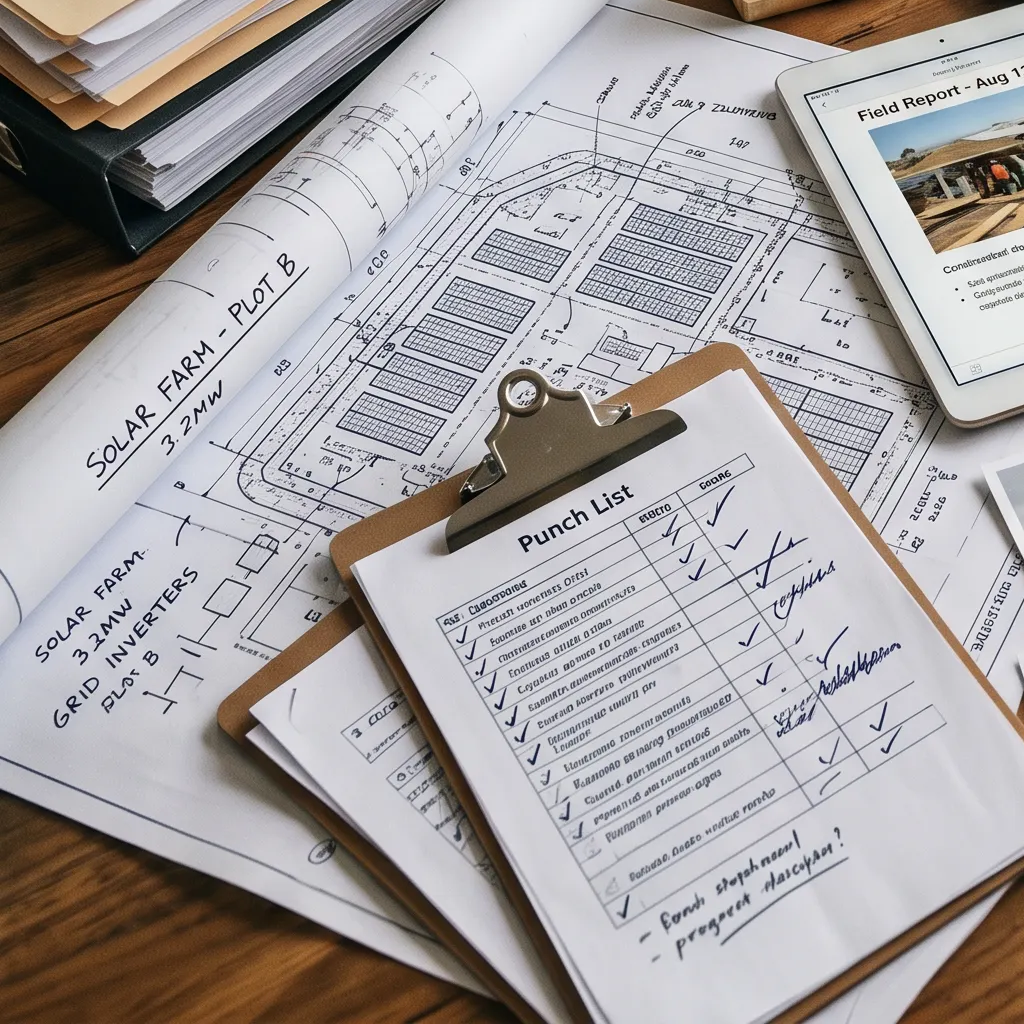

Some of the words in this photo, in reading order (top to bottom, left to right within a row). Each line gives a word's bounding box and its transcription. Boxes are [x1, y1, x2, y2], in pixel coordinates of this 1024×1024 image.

[857, 101, 899, 122] Field
[903, 85, 961, 112] Report
[976, 72, 1009, 92] Aug
[86, 403, 156, 479] SOLAR
[157, 341, 215, 403] FARM
[228, 272, 275, 327] PLOT
[277, 253, 298, 277] B
[161, 380, 225, 456] 3.2MW
[517, 509, 589, 553] Punch
[590, 484, 634, 515] List
[34, 606, 92, 664] SOLAR
[52, 676, 100, 730] GRID
[104, 566, 199, 670] INVERTERS
[143, 650, 159, 669] B
